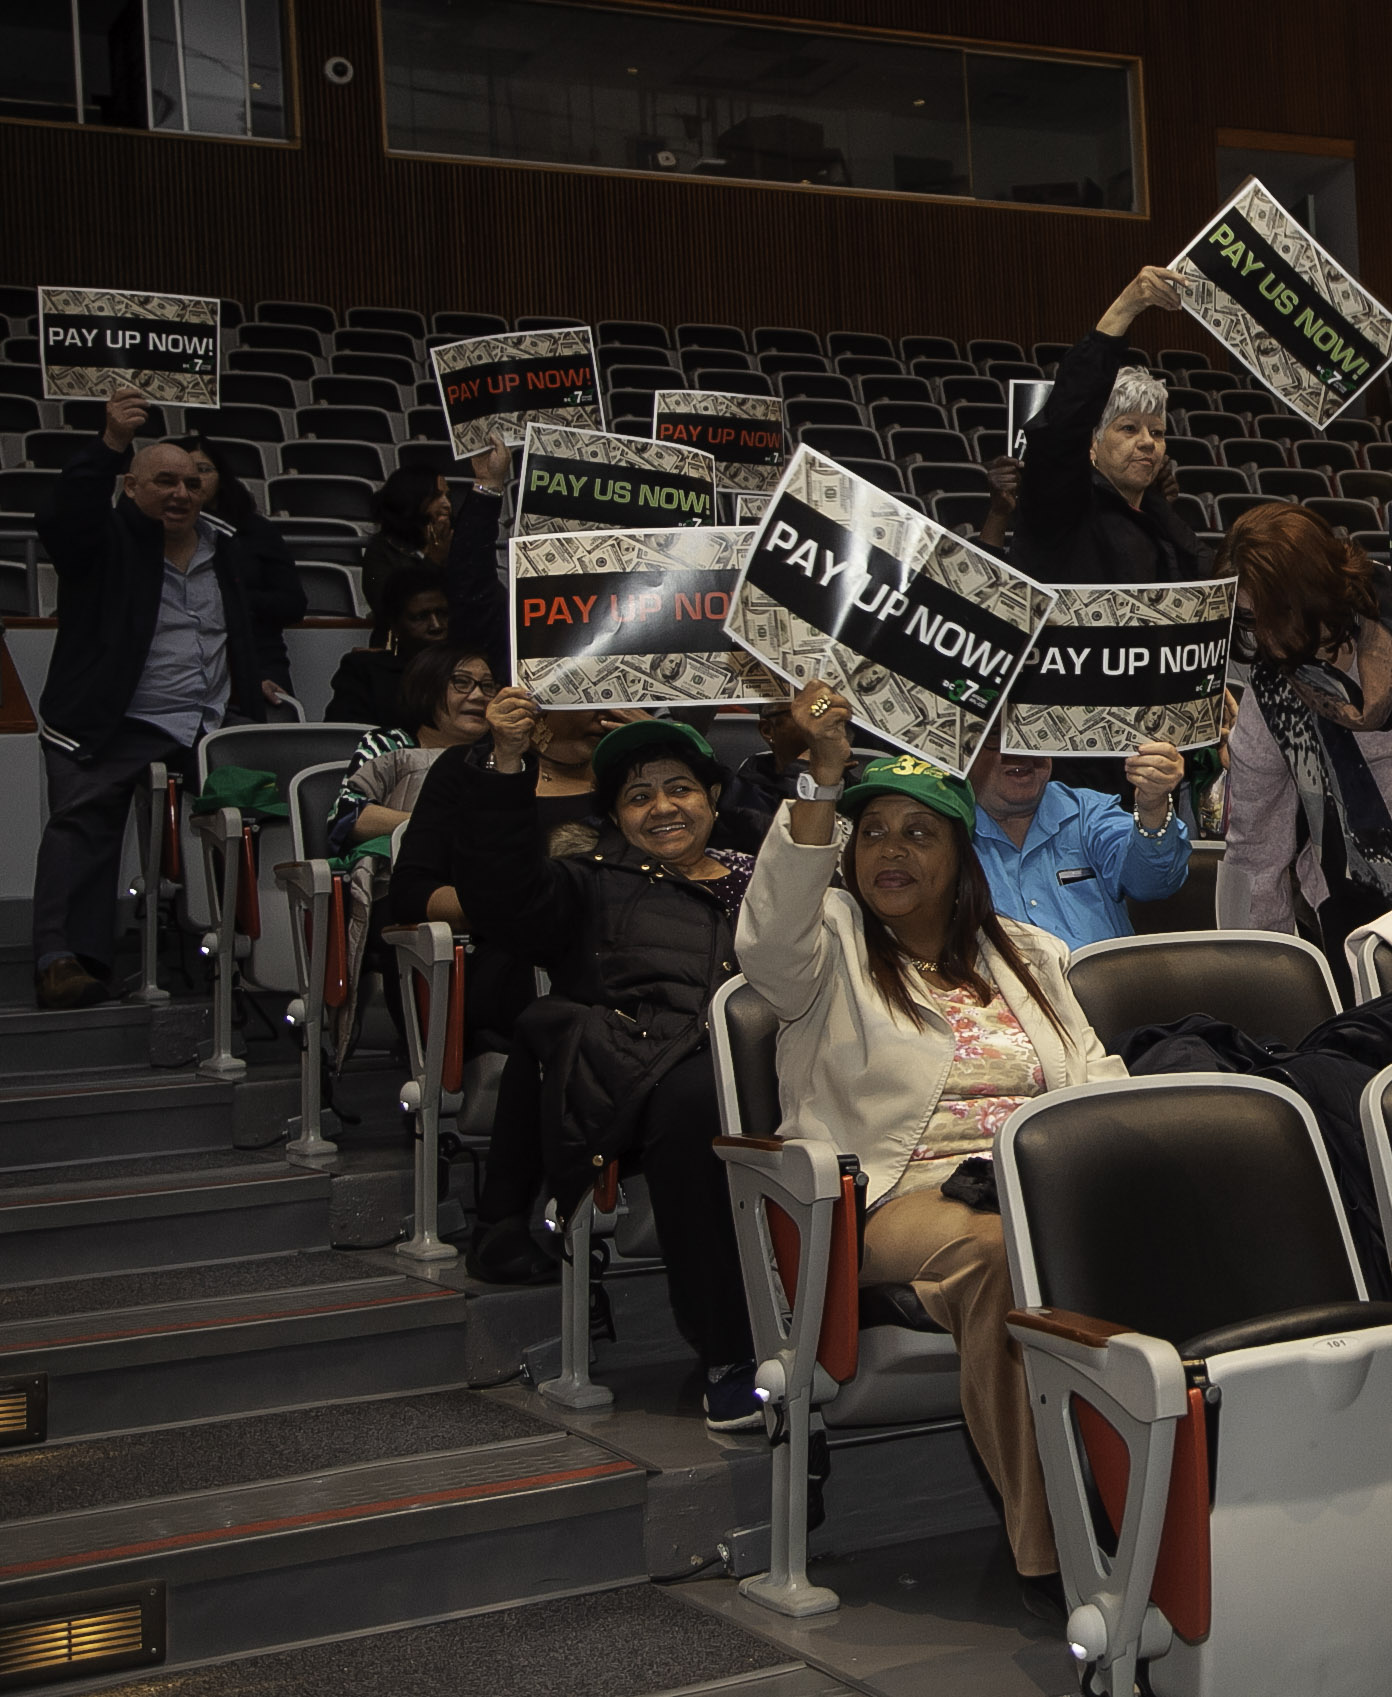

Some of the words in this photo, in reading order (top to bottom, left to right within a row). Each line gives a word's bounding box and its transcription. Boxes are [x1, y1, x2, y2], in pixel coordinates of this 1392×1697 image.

[1209, 223, 1265, 276] PAY
[1258, 272, 1299, 314] US
[1294, 307, 1370, 381] NOW!
[48, 327, 98, 347] PAY
[106, 329, 141, 348] UP
[149, 333, 213, 356] NOW!
[447, 378, 480, 405] PAY
[487, 373, 520, 394] UP
[526, 367, 592, 390] NOW!
[660, 423, 702, 442] PAY
[708, 428, 735, 444] UP
[530, 469, 588, 497] PAY
[594, 478, 631, 503] US
[638, 484, 710, 515] NOW!
[523, 595, 597, 627] PAY
[610, 592, 663, 623] UP
[674, 591, 735, 621] NO
[765, 520, 849, 587] PAY
[852, 571, 910, 621] UP
[904, 605, 1014, 684] NOW!
[1102, 647, 1150, 676] UP
[1160, 638, 1226, 674] NOW!
[892, 754, 931, 775] 37
[1327, 1339, 1347, 1349] 101
